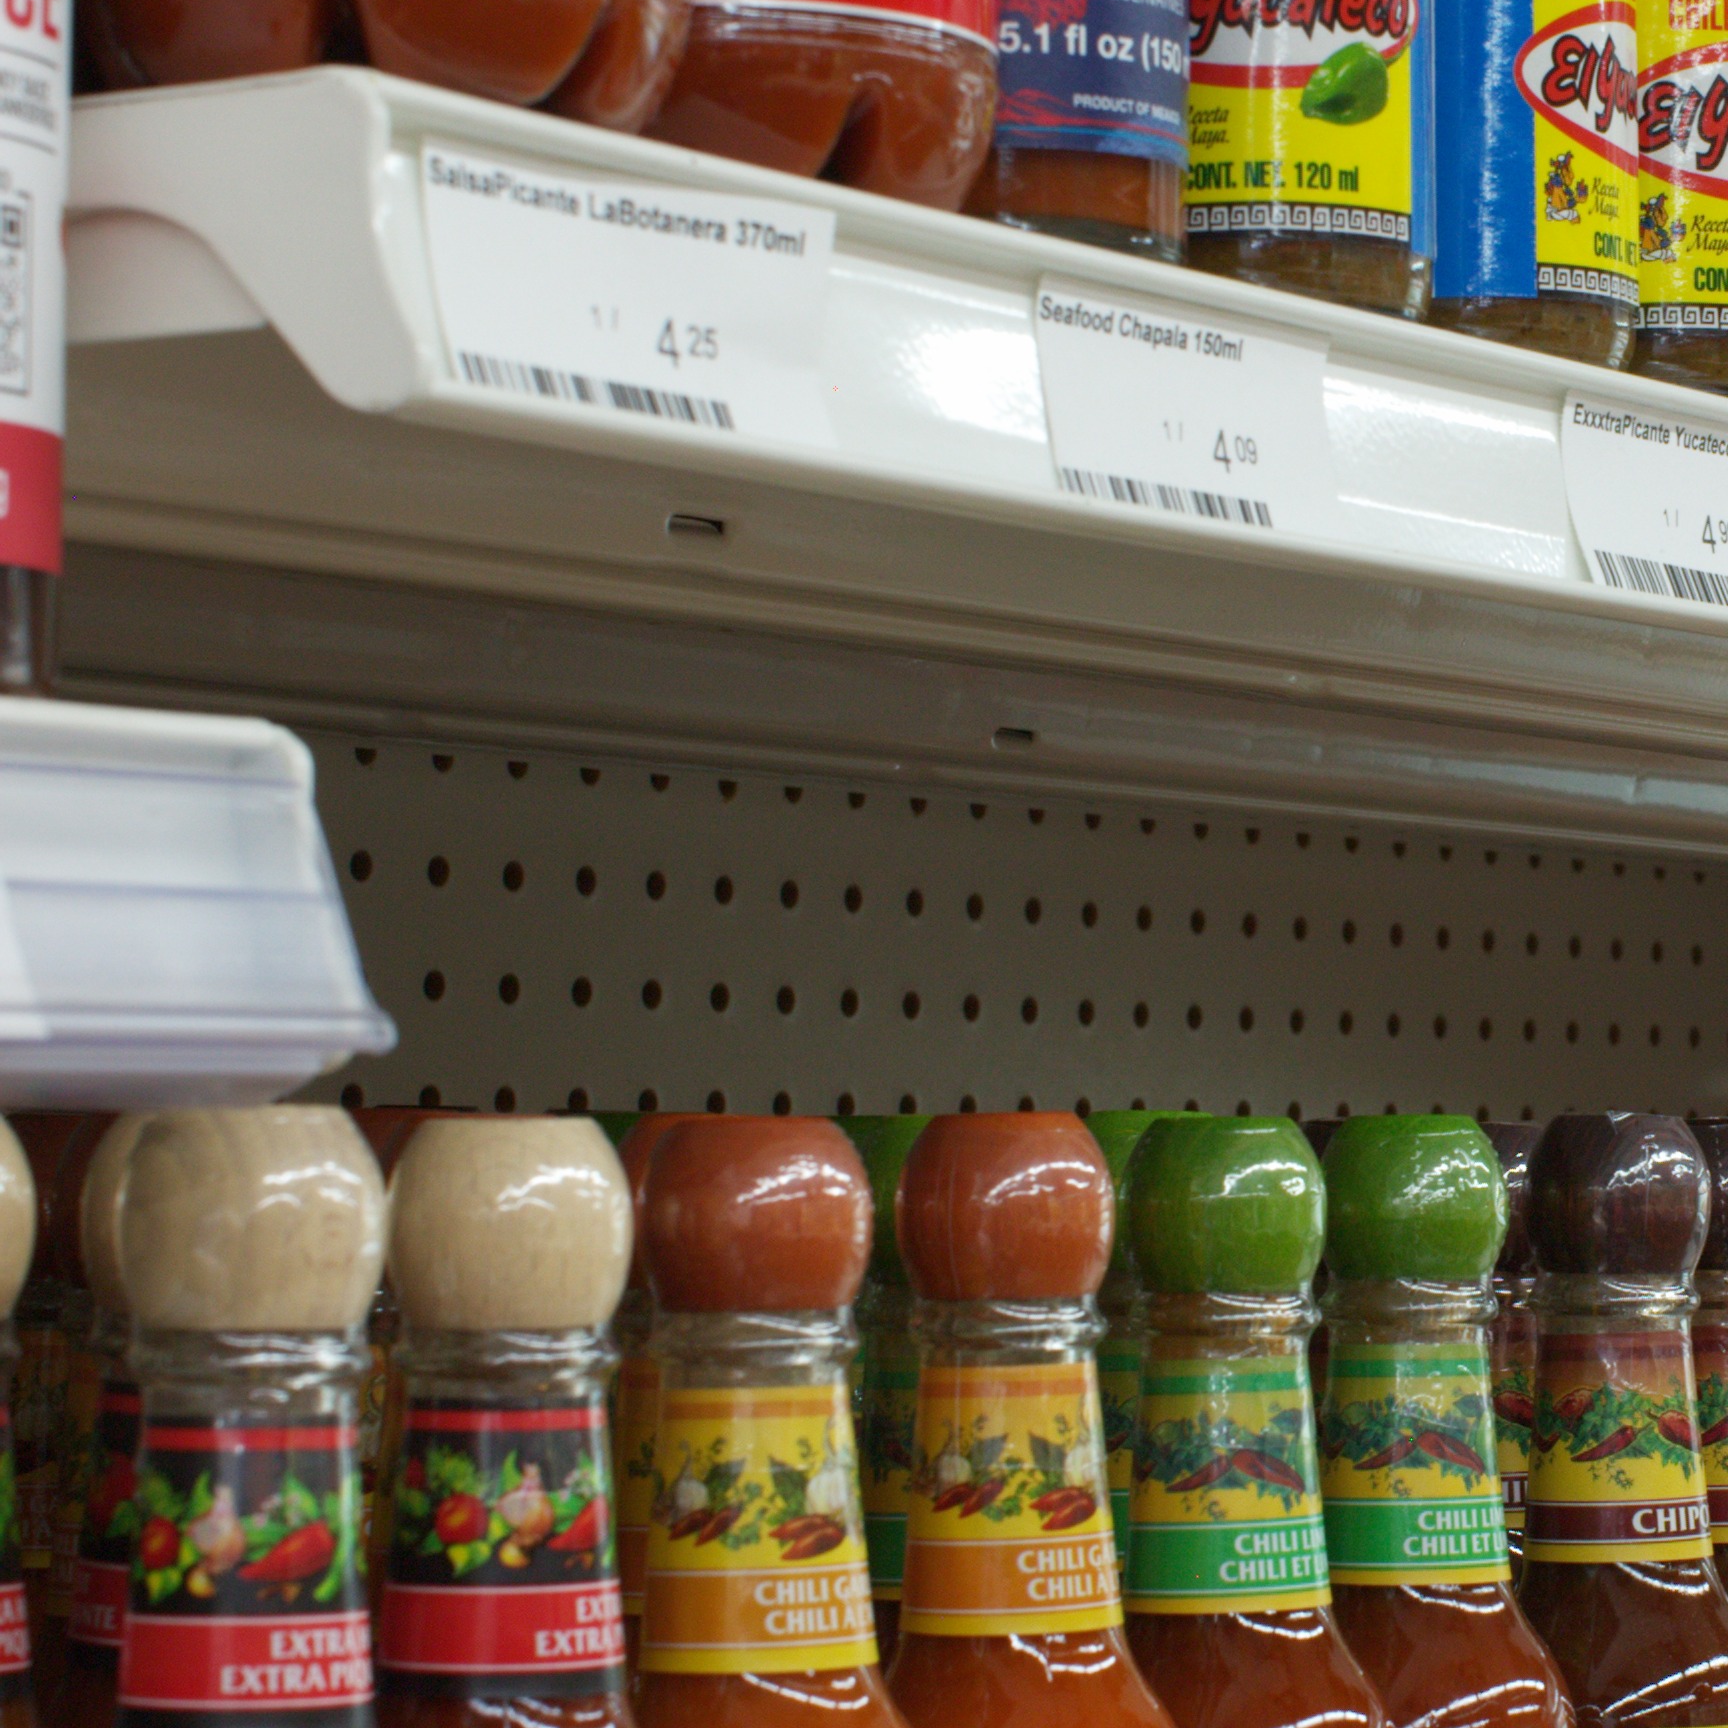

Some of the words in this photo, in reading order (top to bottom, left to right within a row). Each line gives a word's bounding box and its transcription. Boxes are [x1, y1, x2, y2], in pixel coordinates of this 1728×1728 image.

[999, 22, 1056, 55] 5.1
[1064, 24, 1090, 56] fl
[1094, 33, 1134, 60] oz
[1295, 163, 1332, 192] 120
[1338, 164, 1359, 194] ml
[429, 157, 580, 214] SalsaPicante
[588, 194, 726, 243] LaBotanera
[735, 220, 805, 256] 370ml
[1039, 296, 1113, 333] Seafood
[1118, 314, 1188, 350] Chapala
[1195, 332, 1243, 361] 150ml
[1573, 403, 1669, 443] ExxxtraPicante
[1418, 1508, 1478, 1532] CHILI
[754, 1580, 830, 1606] CHILI
[766, 1610, 834, 1636] CHILI
[220, 1667, 320, 1695] EXTRA
